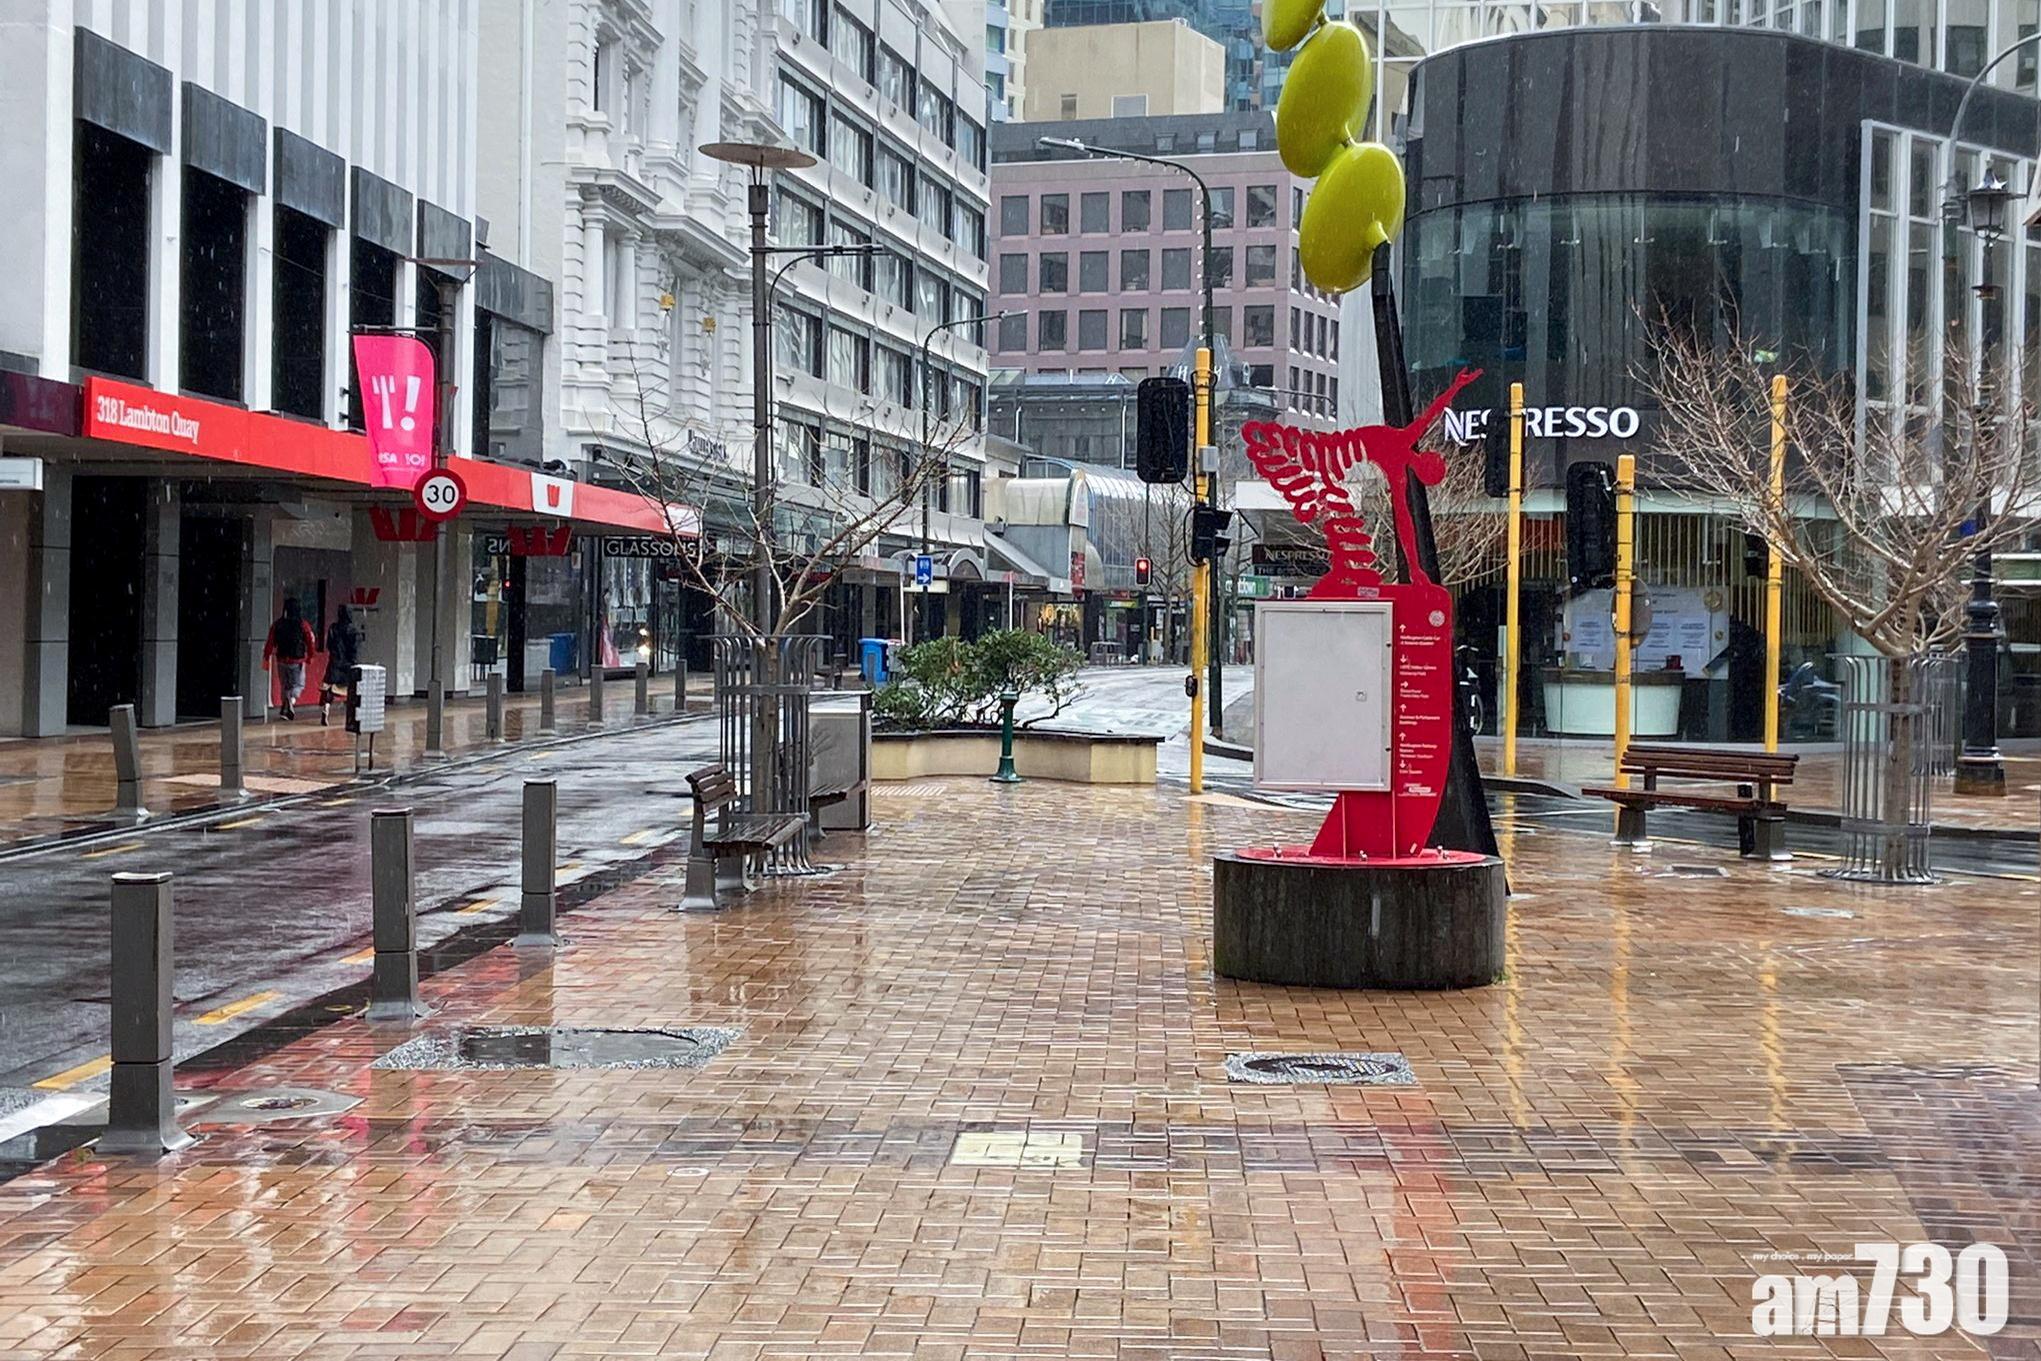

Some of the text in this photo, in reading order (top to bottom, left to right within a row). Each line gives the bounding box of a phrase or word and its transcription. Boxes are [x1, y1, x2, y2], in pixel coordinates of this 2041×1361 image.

[97, 395, 200, 445] 318 Lambton Quay
[1444, 407, 1640, 446] NERESSO
[426, 484, 456, 504] 30
